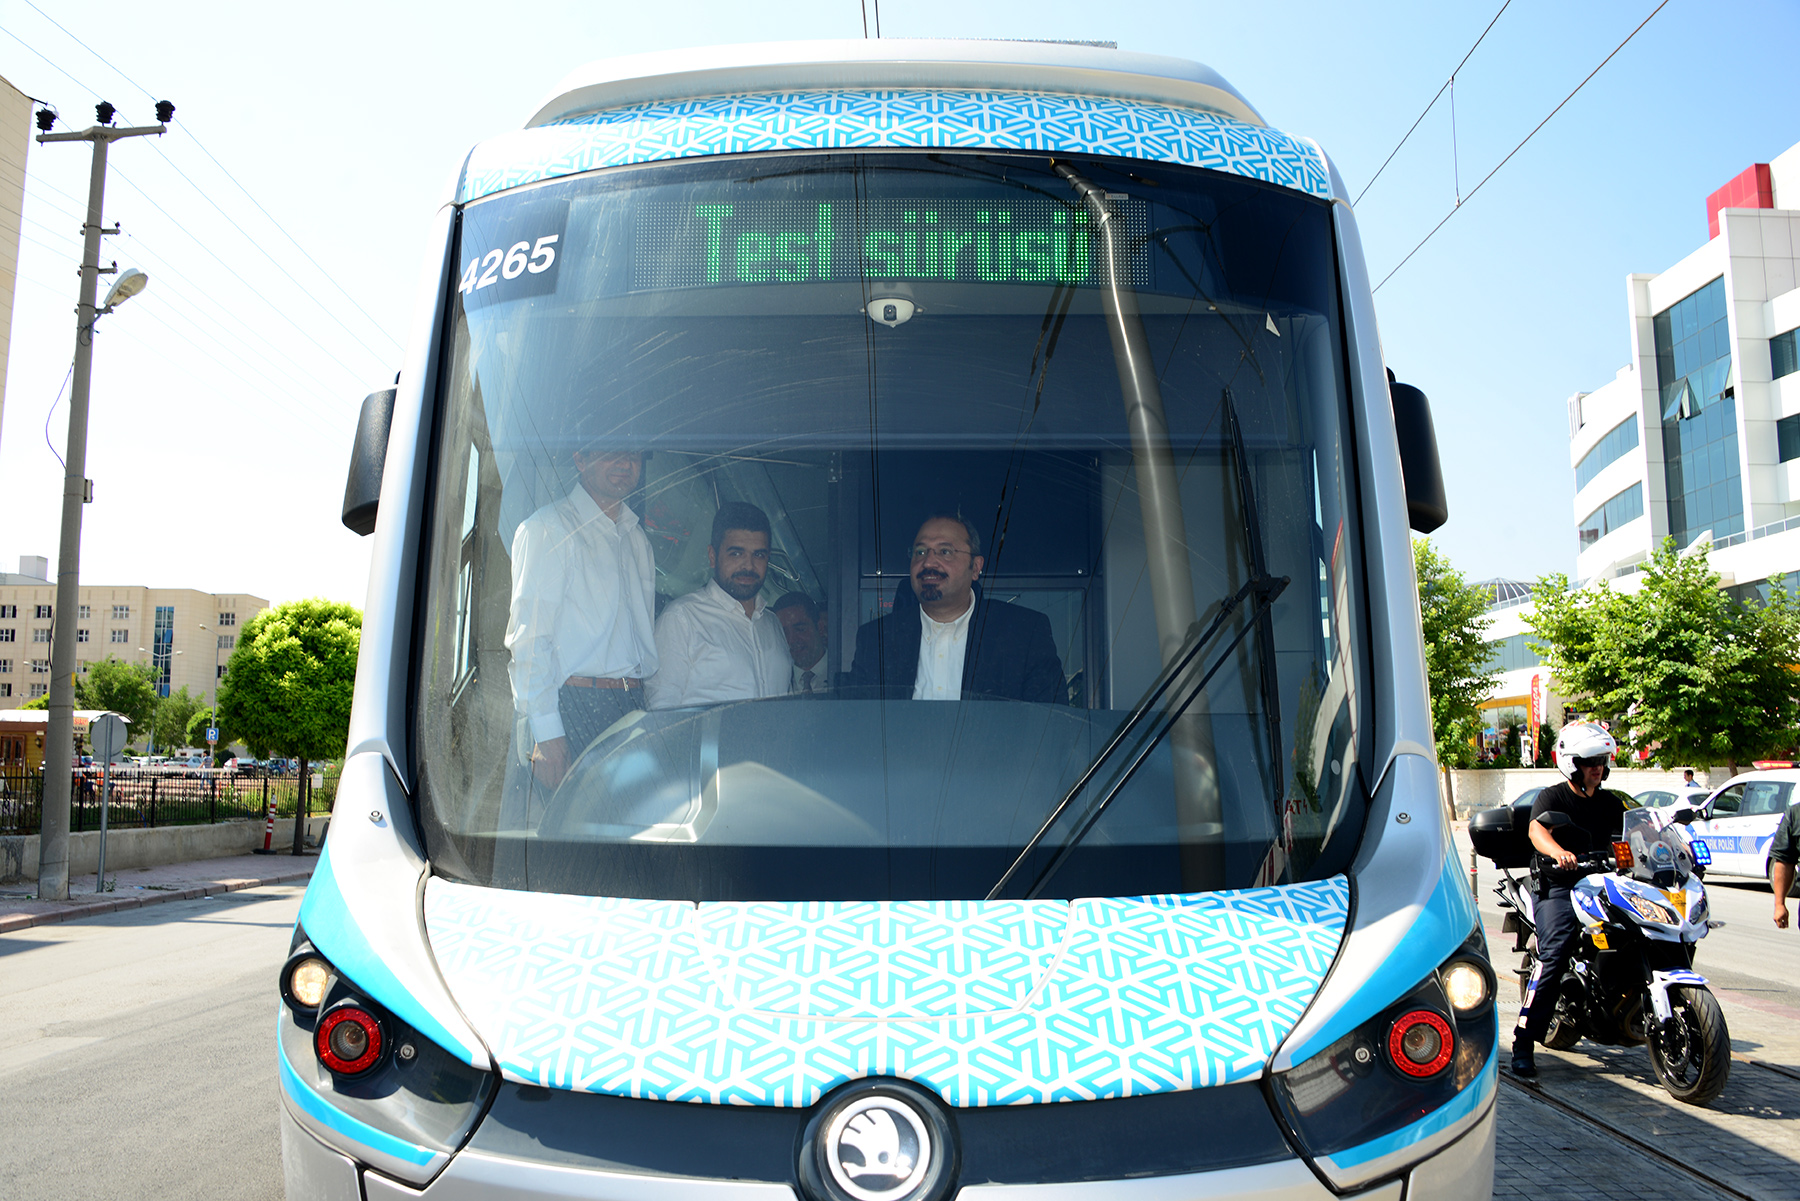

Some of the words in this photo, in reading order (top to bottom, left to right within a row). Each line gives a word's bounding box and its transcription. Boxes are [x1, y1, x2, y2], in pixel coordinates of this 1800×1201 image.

[458, 234, 559, 295] 4265
[696, 203, 836, 282] Test
[866, 211, 1089, 281] sürüsü
